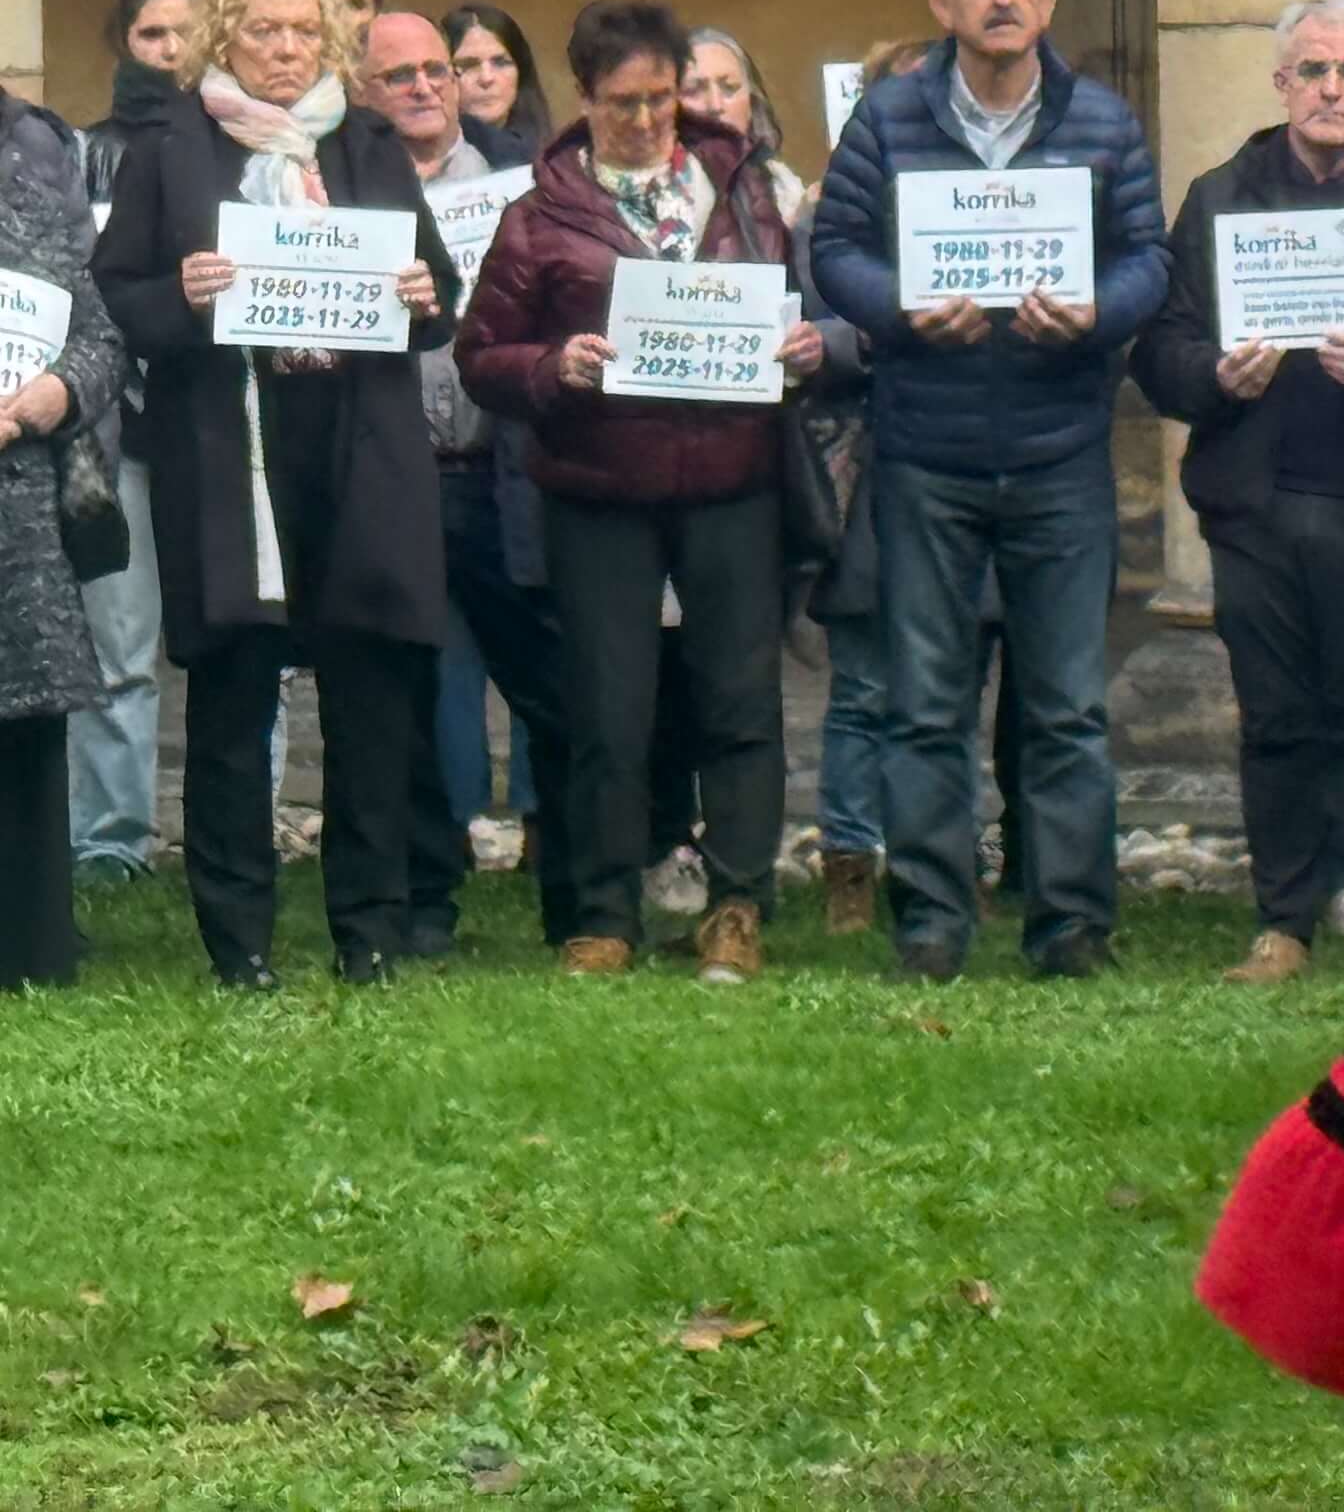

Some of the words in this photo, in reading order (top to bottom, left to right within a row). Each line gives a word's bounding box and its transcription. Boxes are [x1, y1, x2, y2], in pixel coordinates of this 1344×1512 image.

[953, 185, 1036, 211] korrika
[275, 220, 359, 250] korrika
[1234, 229, 1317, 255] korrika
[932, 238, 1064, 263] 1980-11-29
[250, 276, 382, 303] 1980-11-29
[666, 276, 742, 304] korrika
[931, 265, 1065, 289] 2025-11-29
[244, 303, 381, 330] 2025-11-29
[638, 329, 762, 355] 1980-11-29
[632, 354, 759, 383] 2025-11-29
